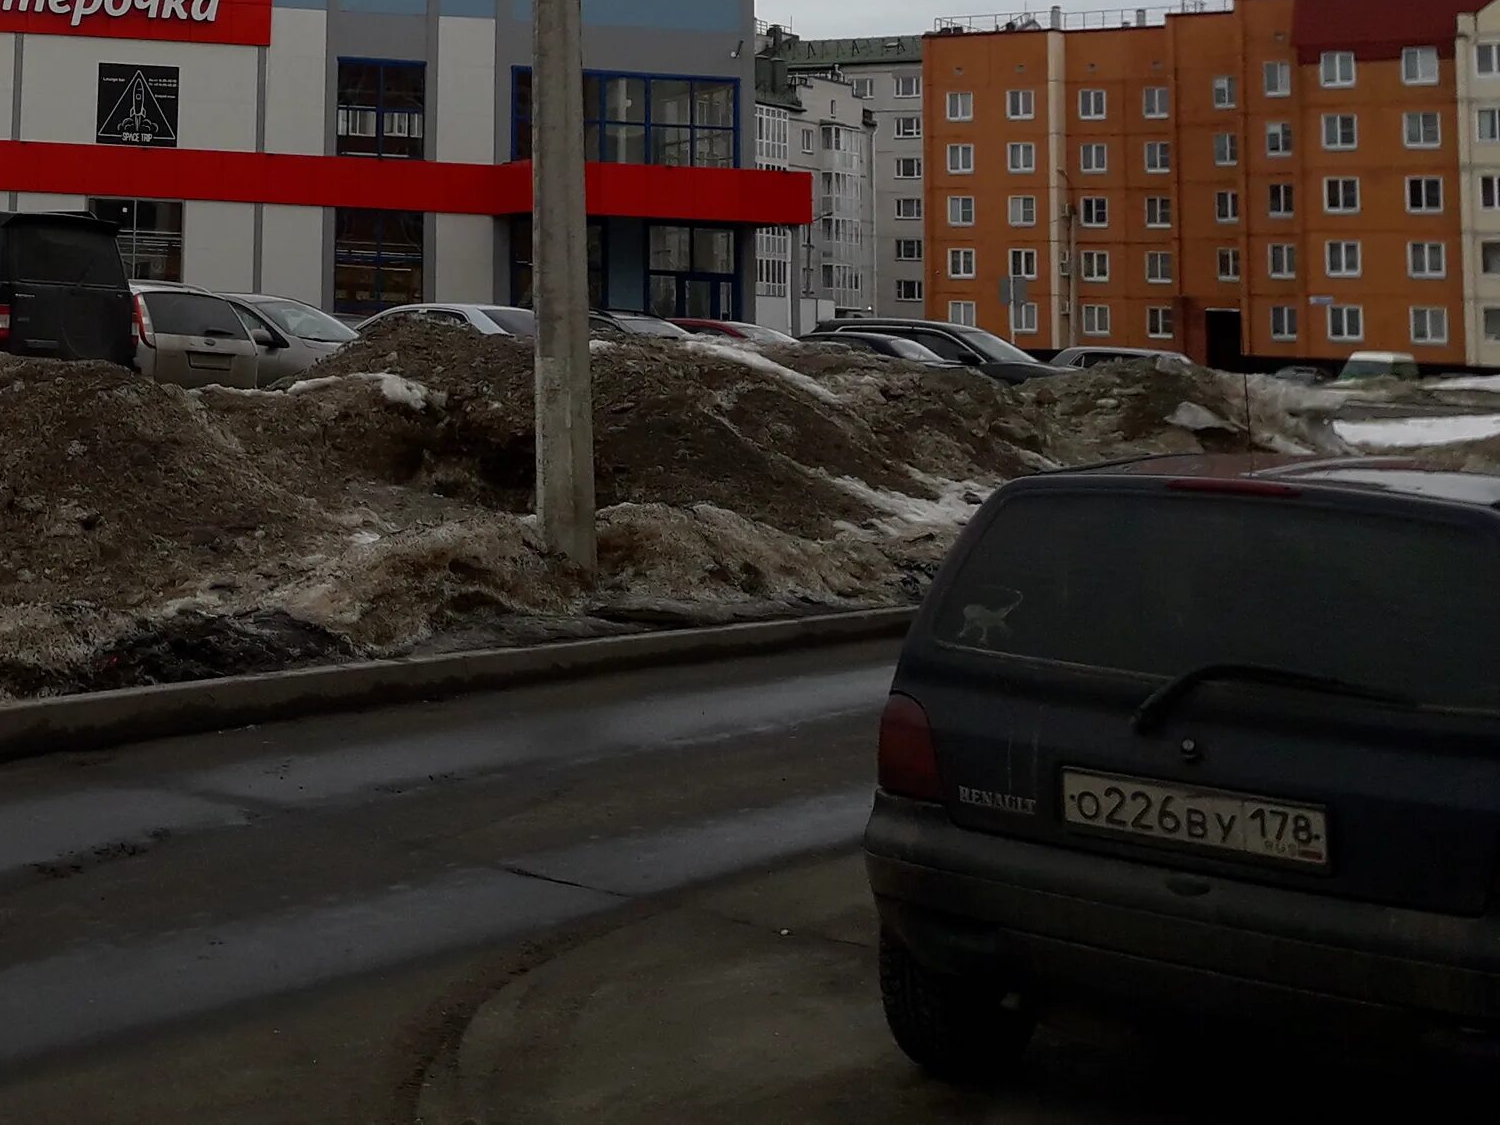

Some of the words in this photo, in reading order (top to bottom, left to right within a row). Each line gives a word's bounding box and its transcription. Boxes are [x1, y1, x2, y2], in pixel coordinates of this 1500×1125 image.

[122, 131, 140, 142] SPACE
[141, 133, 153, 143] TRIP
[958, 784, 1037, 815] RENAULT
[1249, 807, 1313, 844] 178
